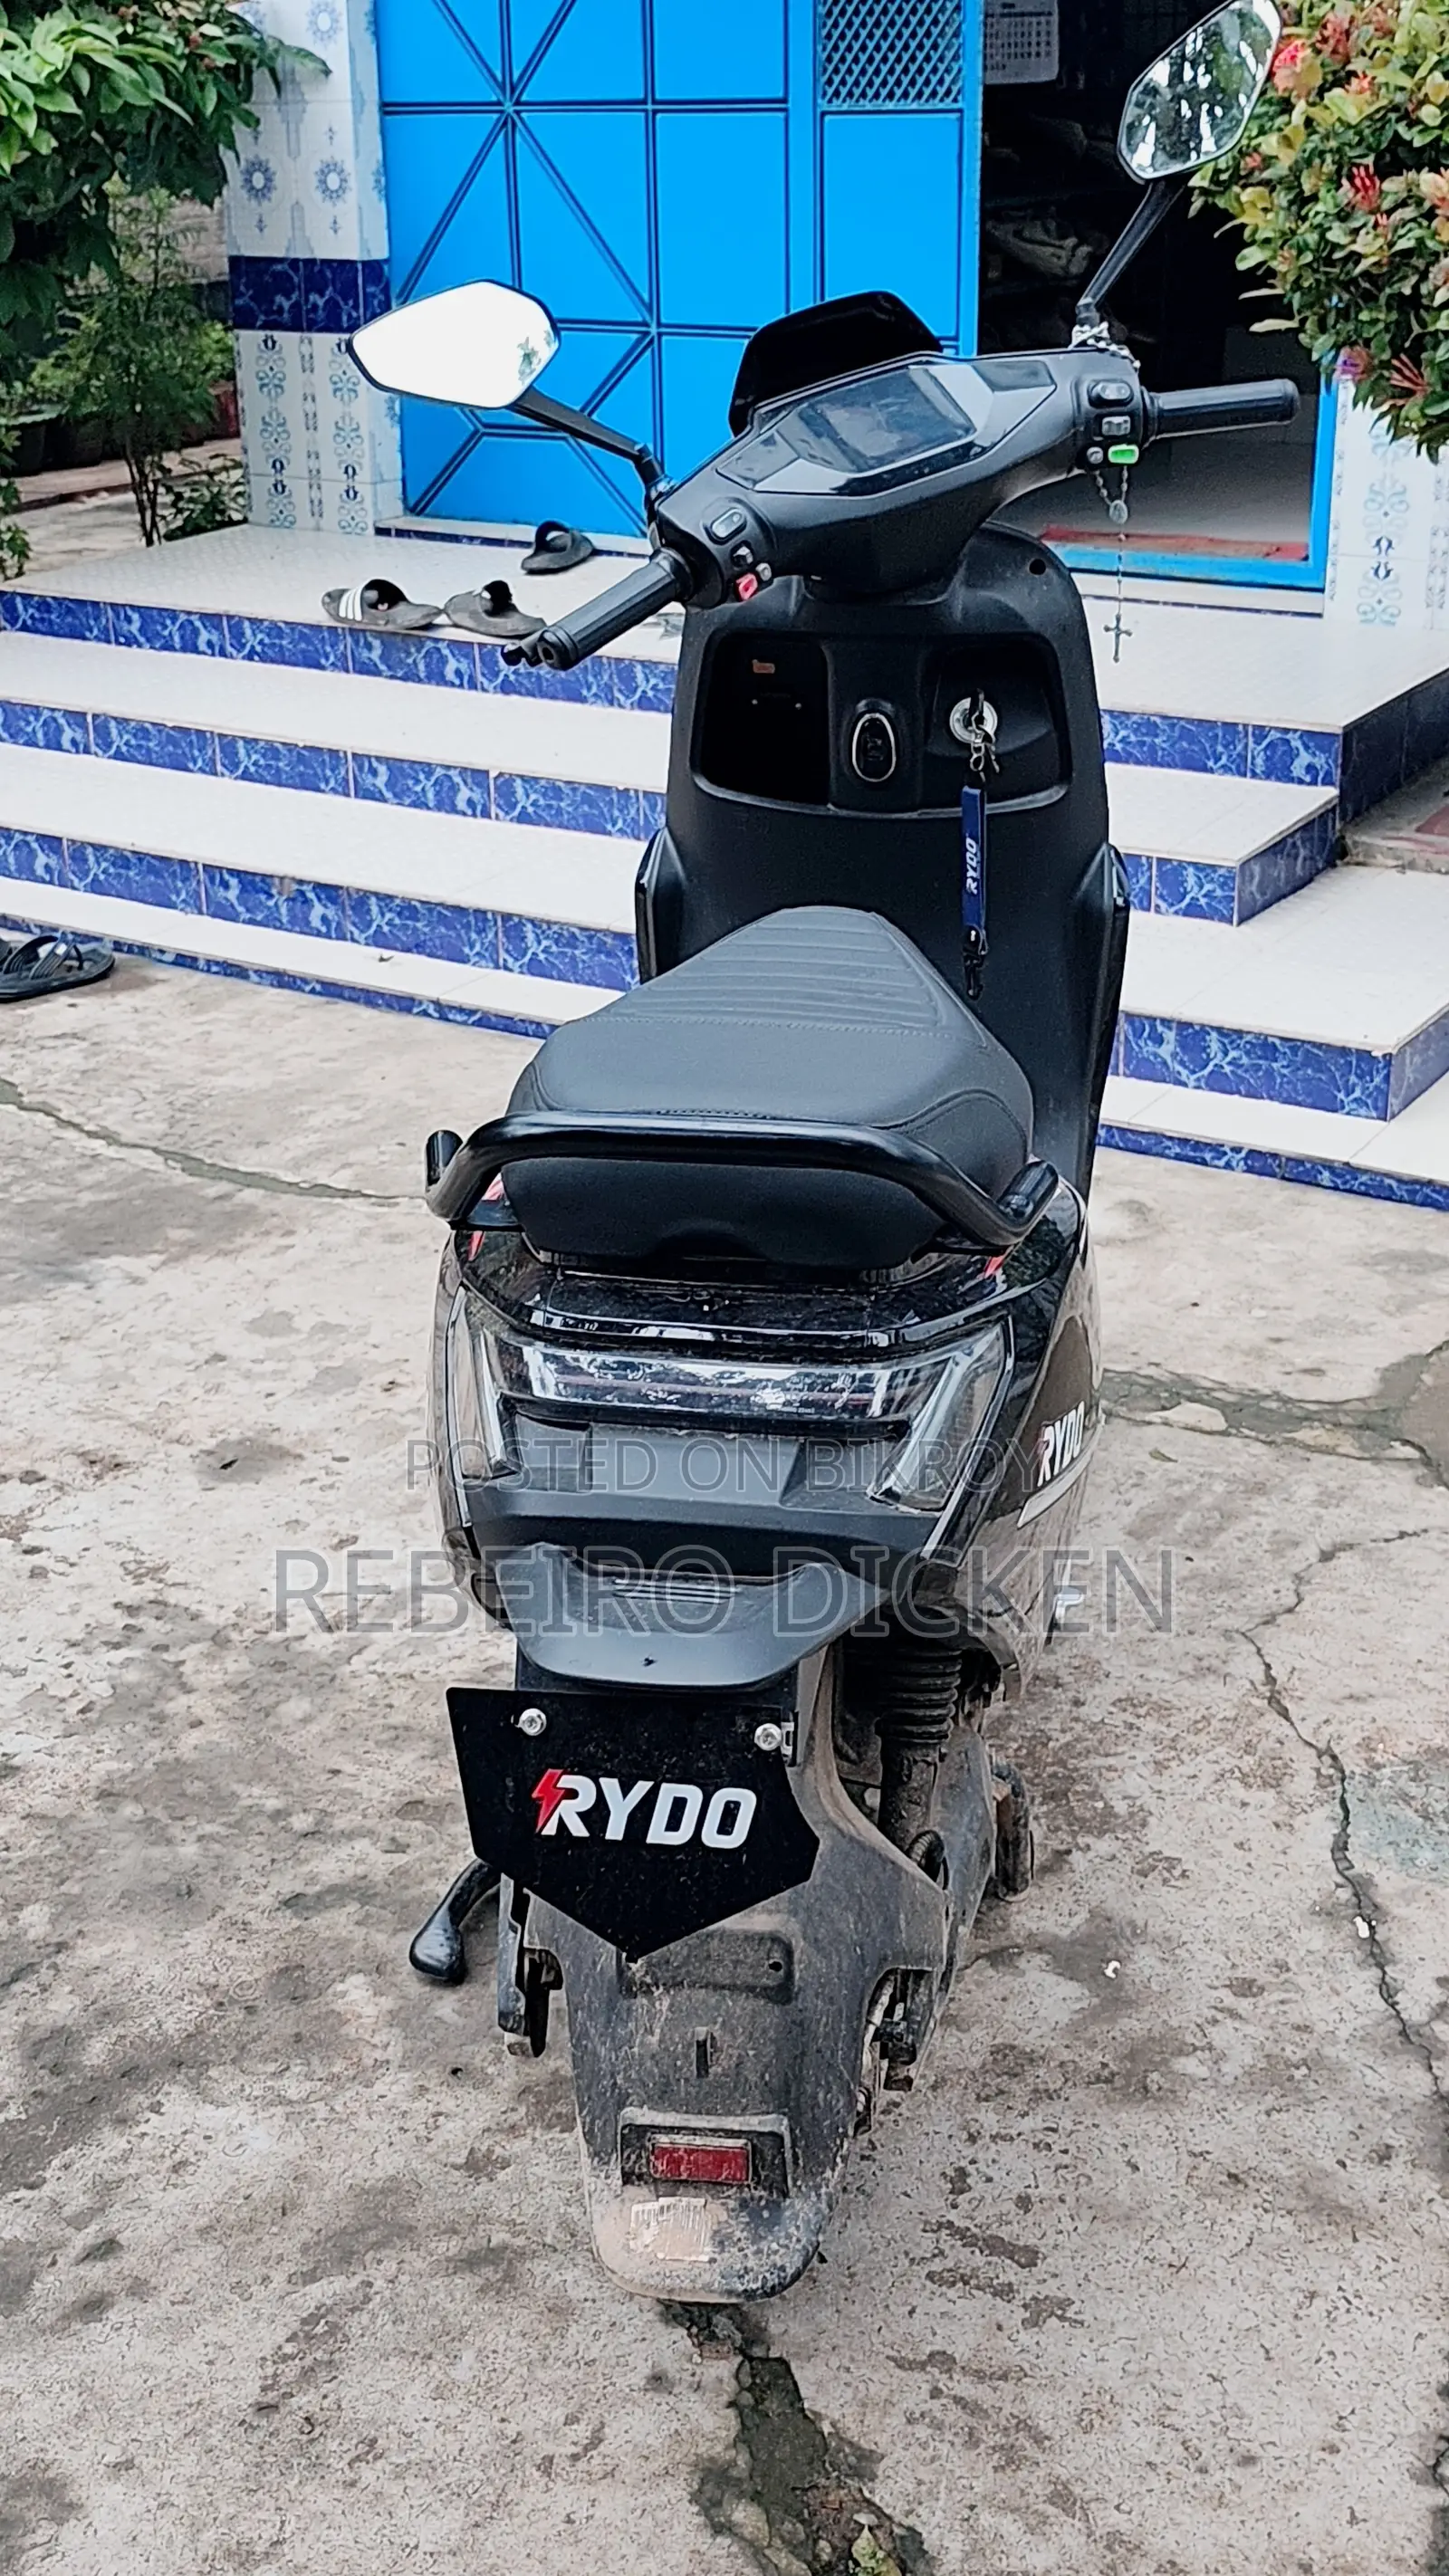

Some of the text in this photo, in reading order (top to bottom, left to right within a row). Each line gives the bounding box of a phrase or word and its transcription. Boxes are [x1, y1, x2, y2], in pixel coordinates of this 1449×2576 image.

[965, 837, 977, 895] RYDO
[1037, 1401, 1085, 1487] RYDO
[534, 1771, 757, 1849] RYDO
